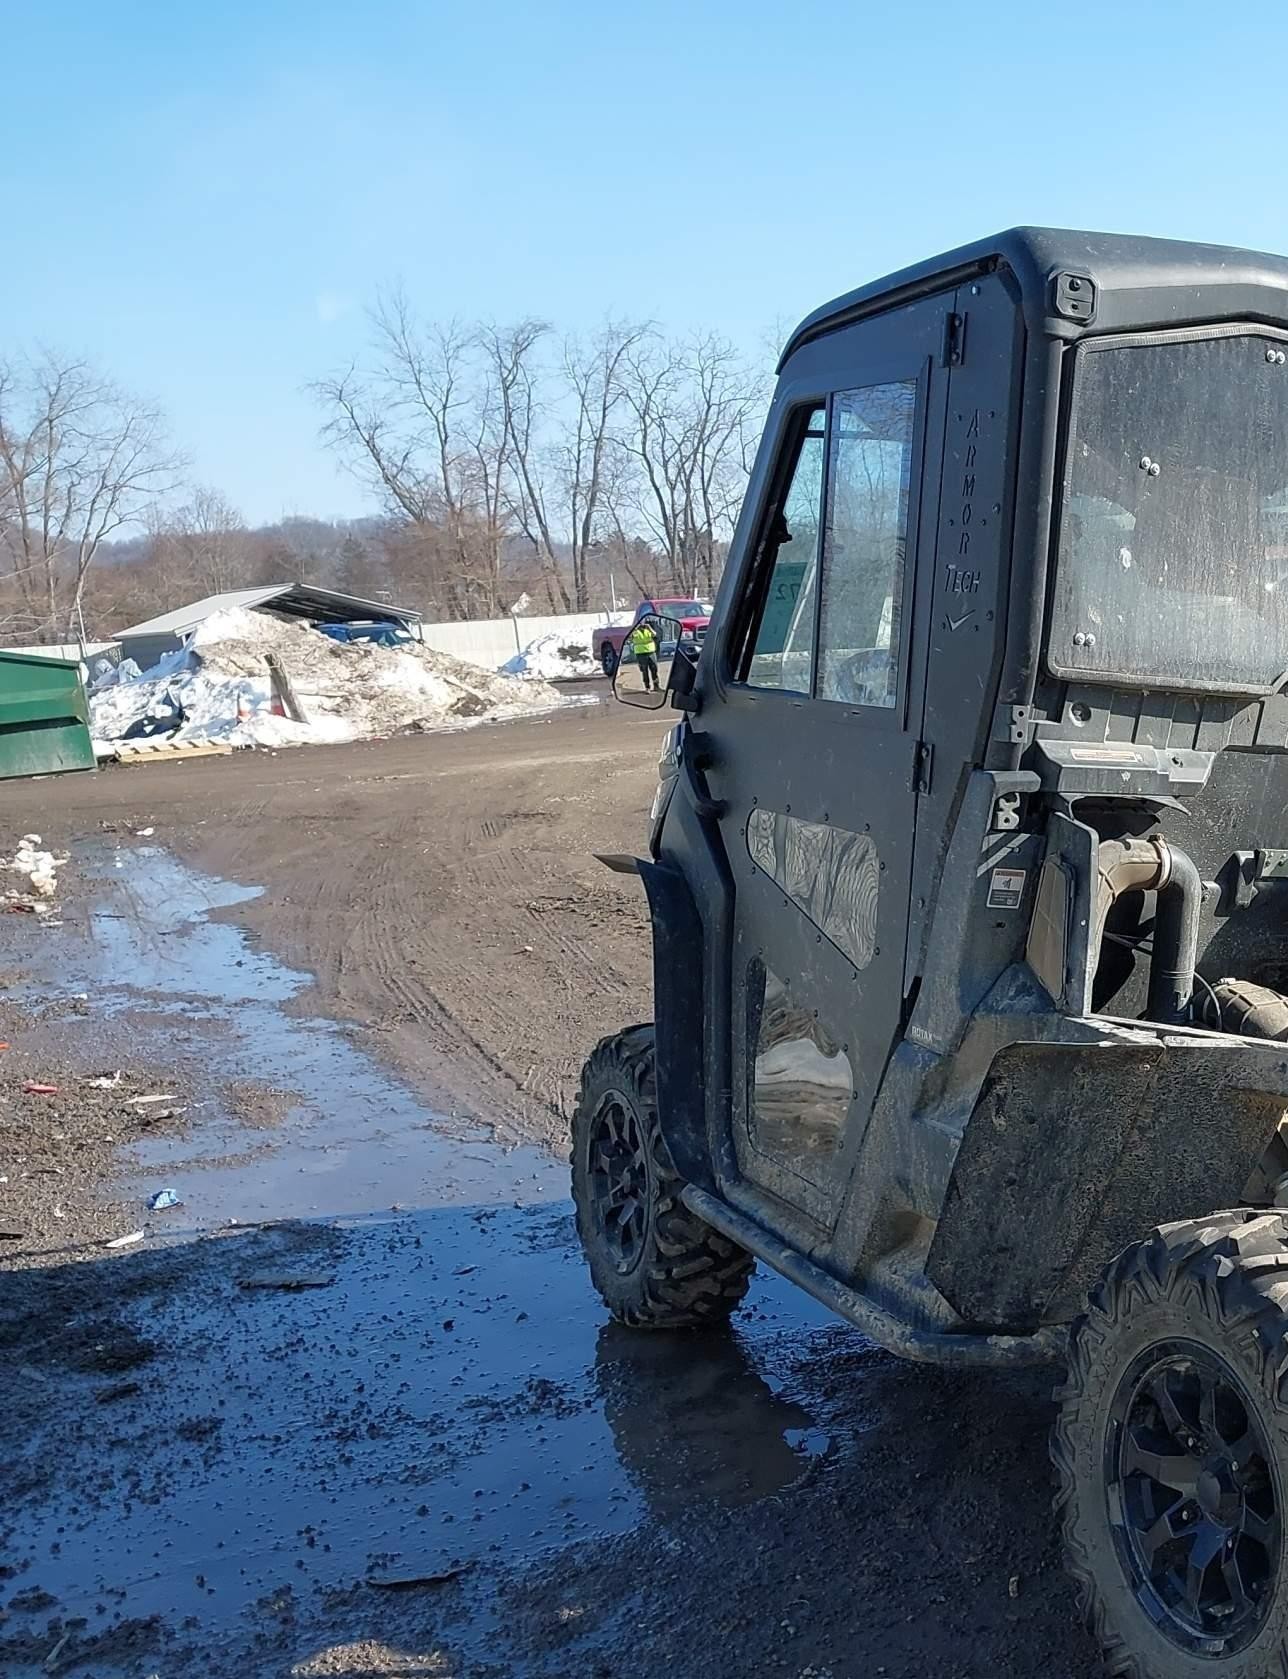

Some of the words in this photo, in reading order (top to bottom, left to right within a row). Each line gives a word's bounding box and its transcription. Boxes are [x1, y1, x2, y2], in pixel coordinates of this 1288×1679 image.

[959, 409, 979, 554] ARMOR
[944, 564, 981, 594] TECH
[911, 1025, 933, 1043] ROTAX
